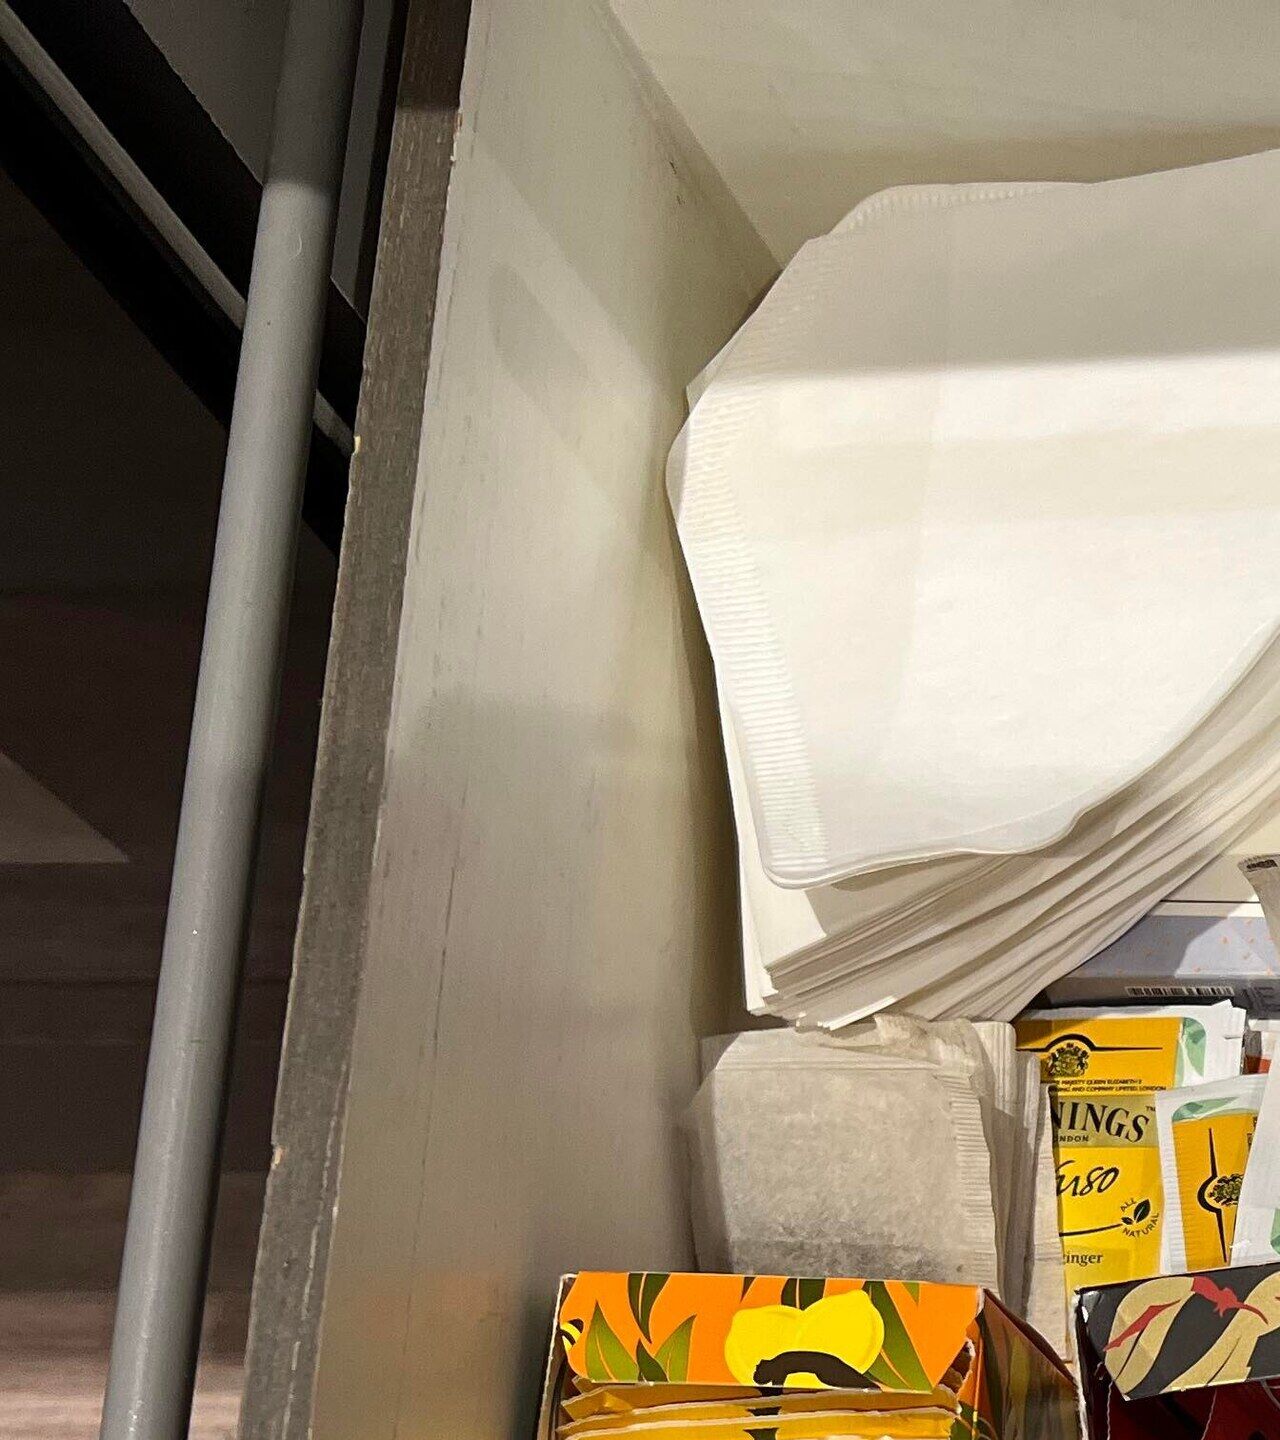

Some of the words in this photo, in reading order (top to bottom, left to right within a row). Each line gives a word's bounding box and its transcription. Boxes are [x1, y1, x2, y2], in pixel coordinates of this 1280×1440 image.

[1051, 1101, 1149, 1143] NINGS
[1120, 1197, 1137, 1212] ALL
[1122, 1212, 1159, 1238] NATURAL
[1063, 1251, 1103, 1268] inger
